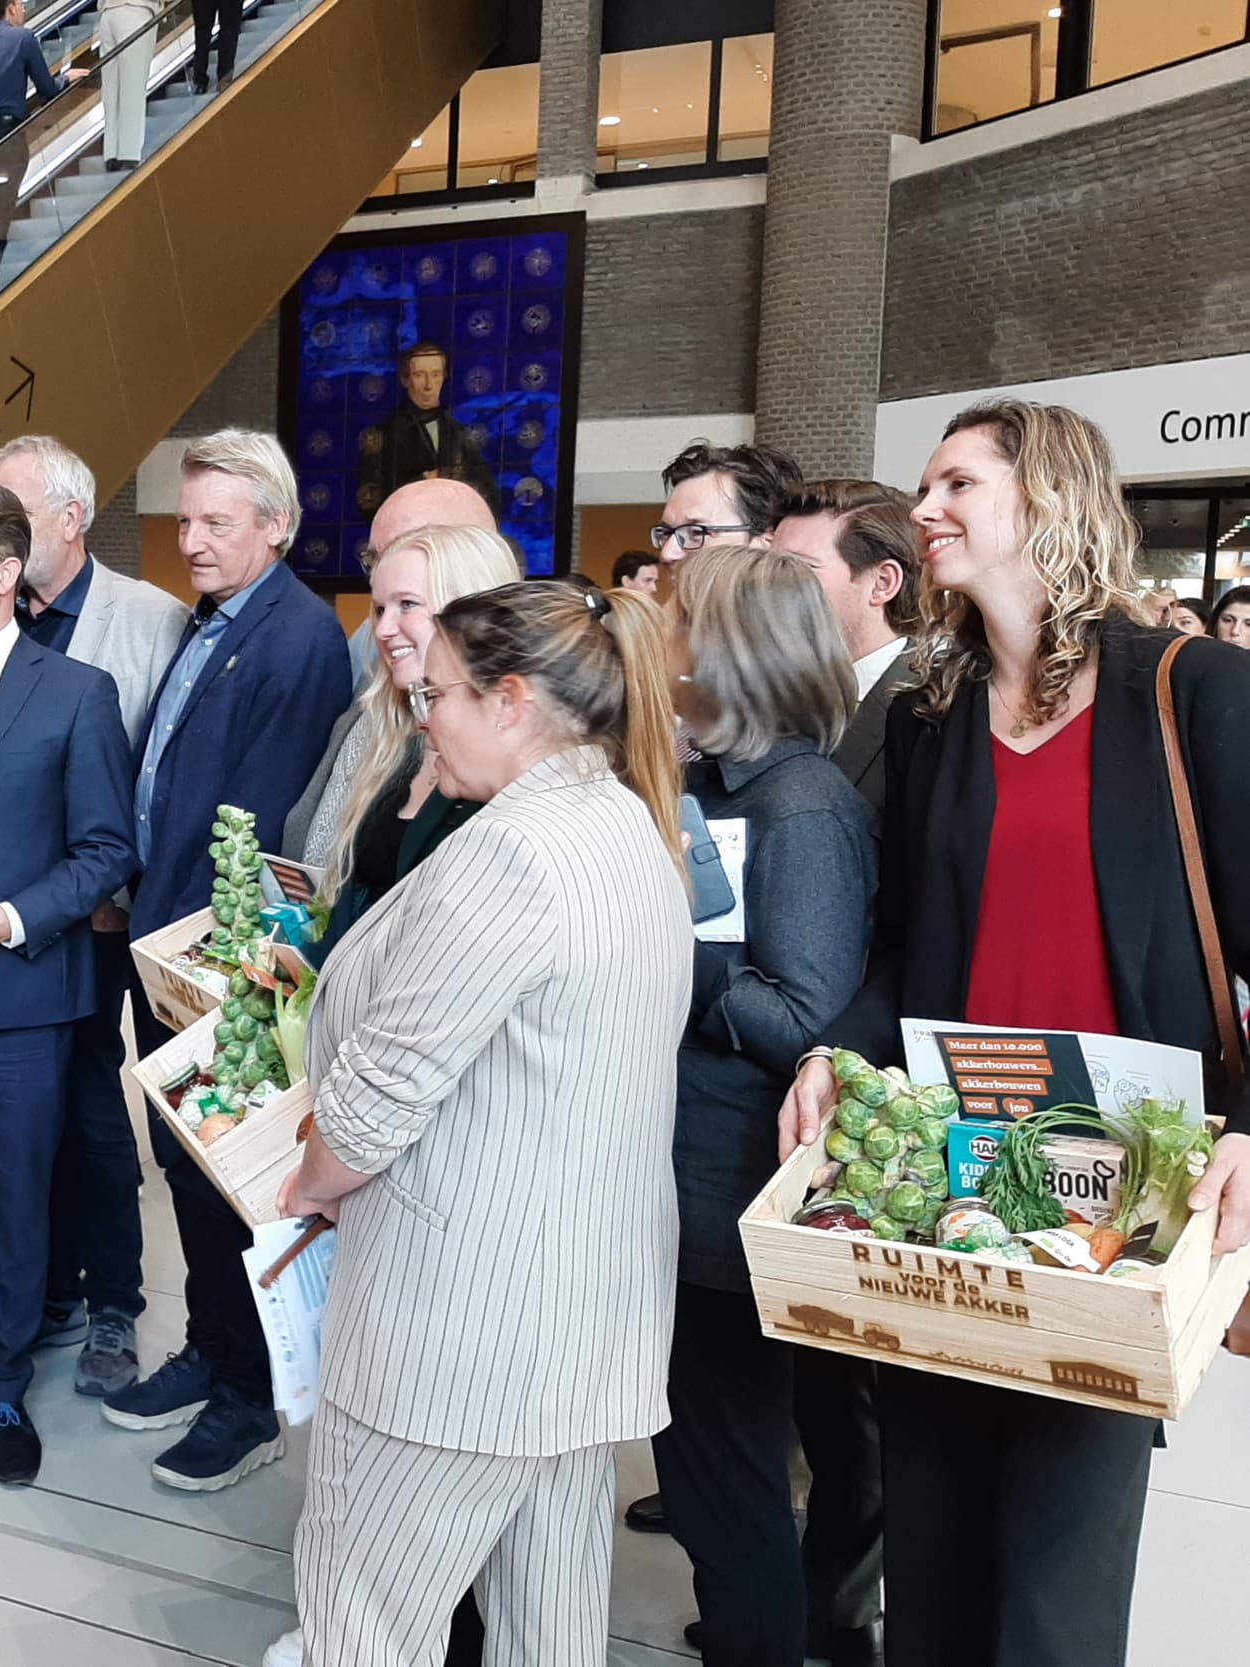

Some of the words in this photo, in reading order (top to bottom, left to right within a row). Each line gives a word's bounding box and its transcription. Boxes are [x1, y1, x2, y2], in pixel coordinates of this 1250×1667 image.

[949, 1041, 977, 1051] Meer
[980, 1041, 1001, 1051] dan
[1003, 1043, 1042, 1051] 10.000
[961, 1079, 1042, 1091] akkerbouwen
[966, 1101, 994, 1110] voor
[1009, 1101, 1029, 1114] jou
[970, 1141, 1000, 1155] HAK
[1042, 1170, 1108, 1201] BOON
[852, 1243, 1025, 1289] RUIMTE
[899, 1272, 946, 1289] voor
[954, 1279, 980, 1295] de
[859, 1276, 946, 1304] NIEUWE
[953, 1293, 1030, 1319] AKKER
